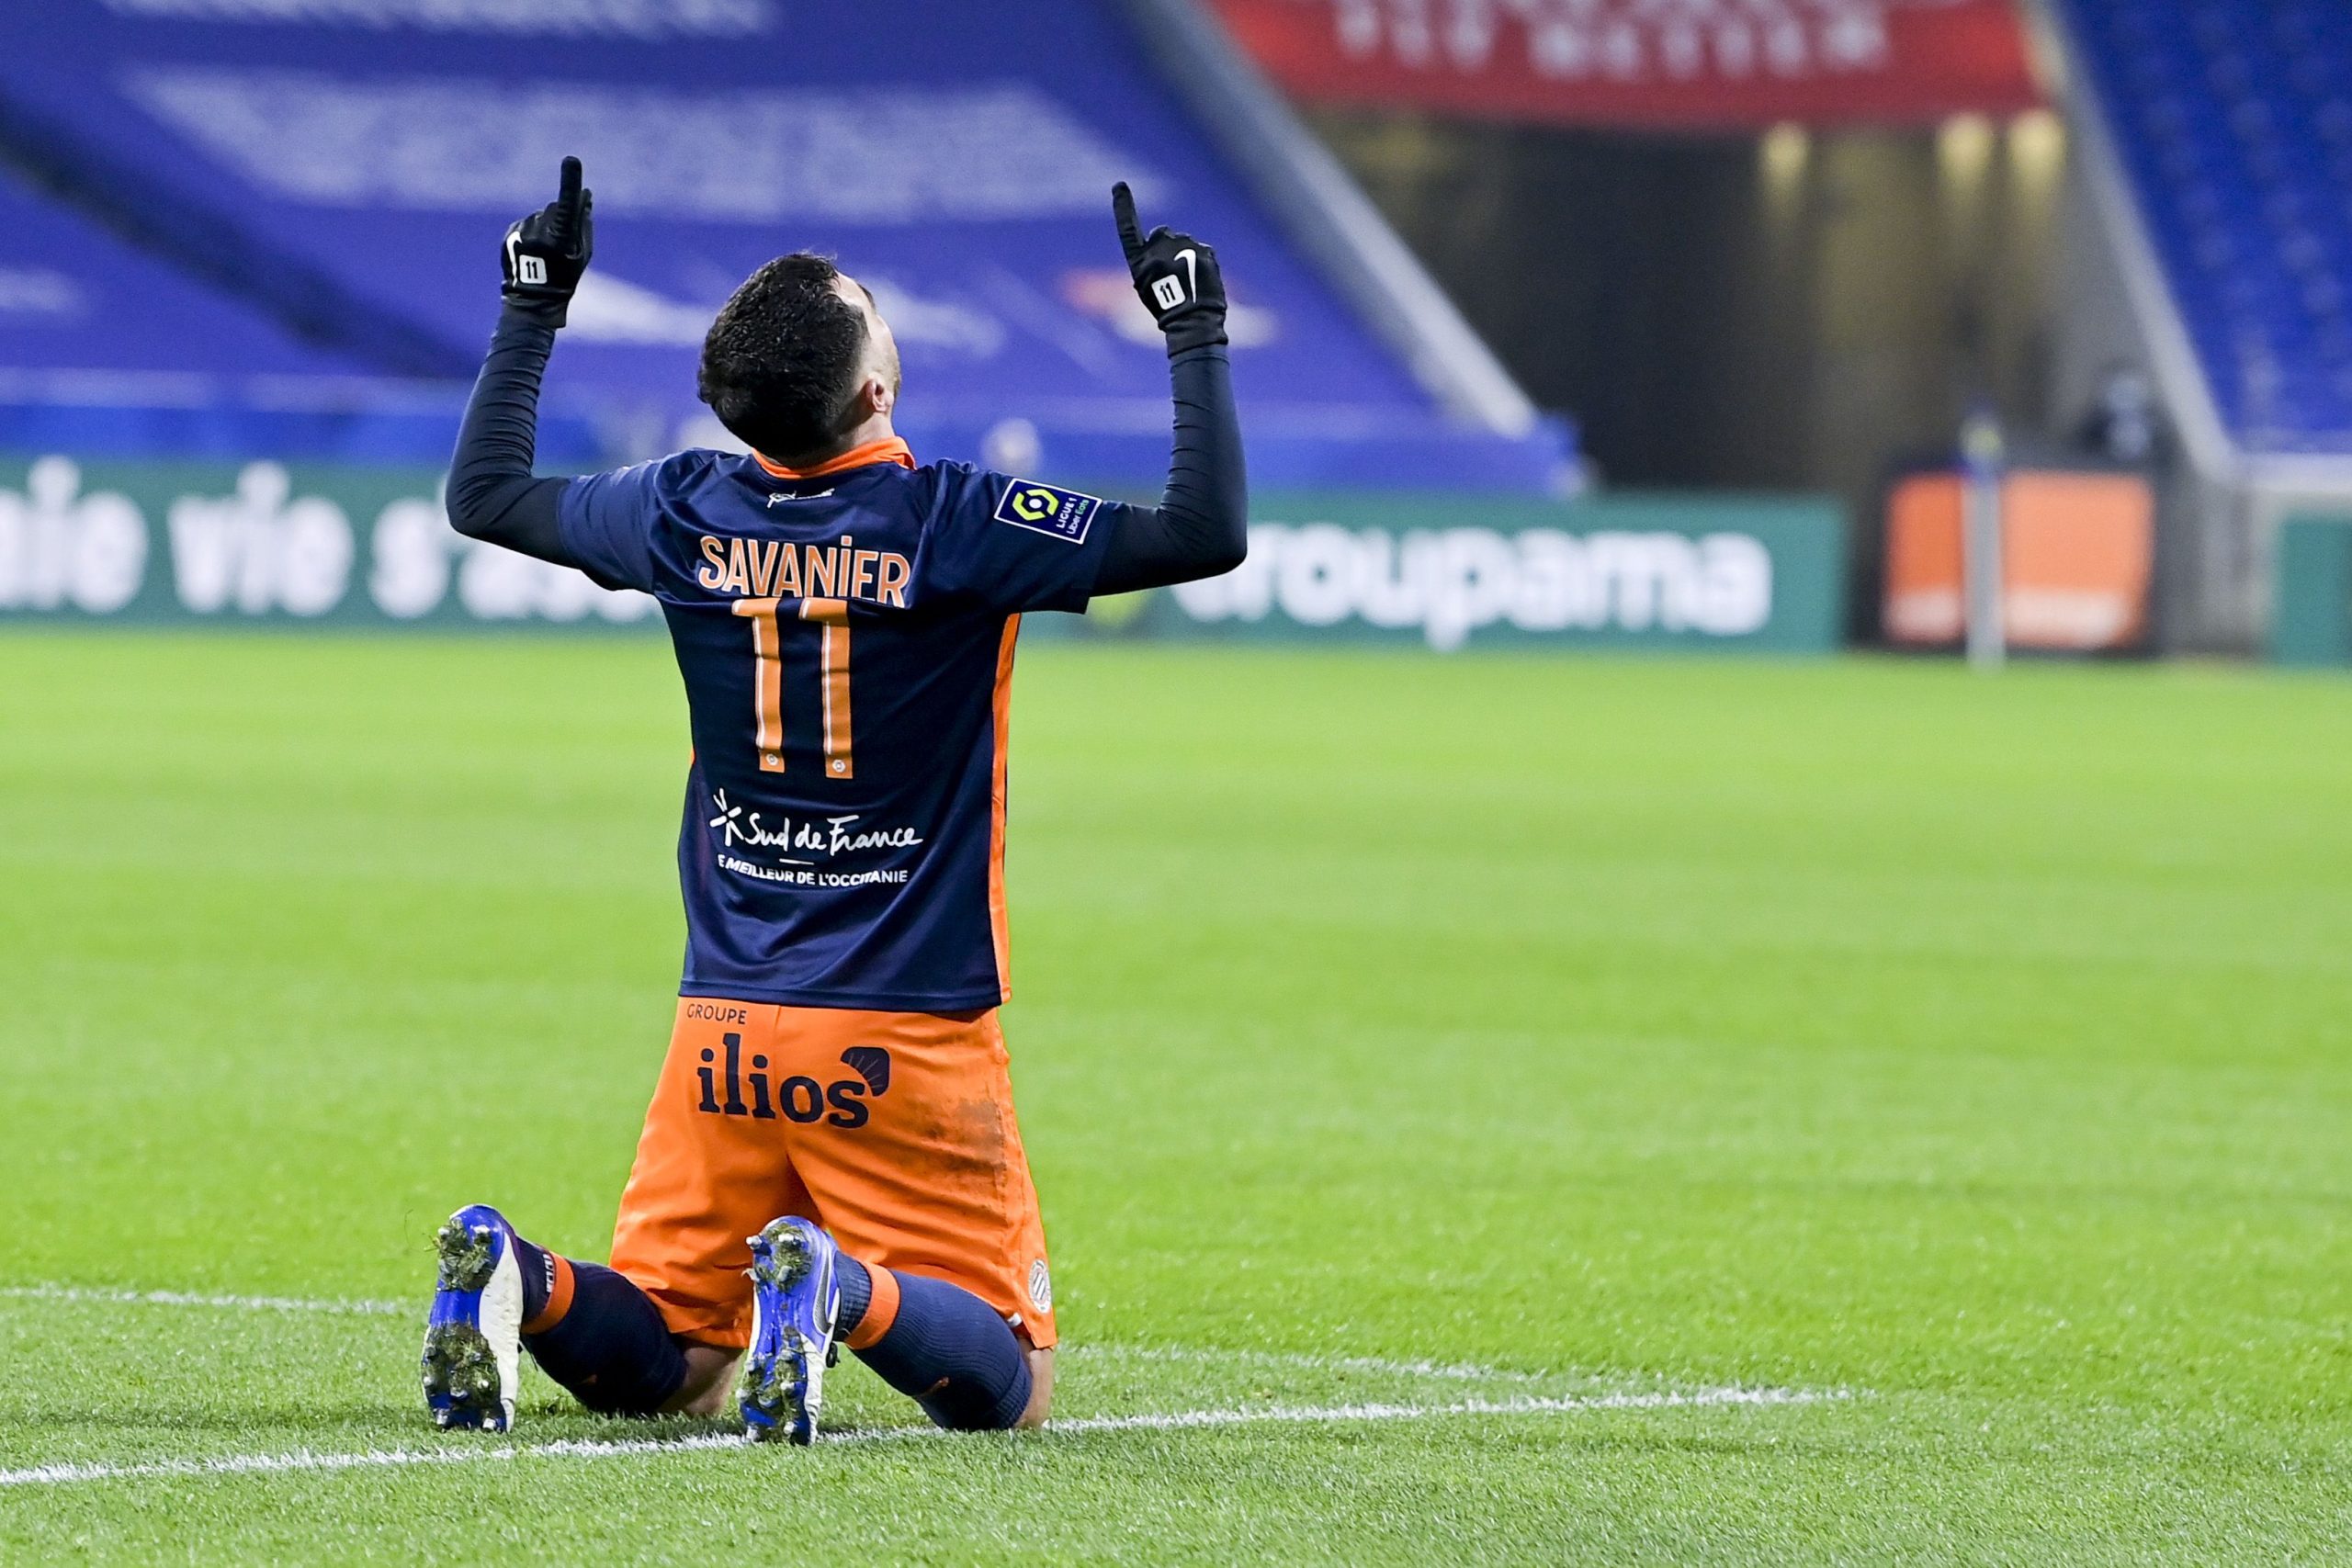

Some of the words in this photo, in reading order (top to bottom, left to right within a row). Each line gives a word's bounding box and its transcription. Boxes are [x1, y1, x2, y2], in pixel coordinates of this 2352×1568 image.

[525, 261, 538, 279] 11
[1159, 282, 1176, 303] 11
[167, 459, 355, 615] vie
[1171, 522, 1773, 652] roupama
[731, 596, 853, 779] 11
[744, 812, 790, 852] Sud
[794, 823, 828, 850] de
[827, 815, 923, 856] France
[725, 858, 795, 884] MEILLEUR
[797, 871, 816, 886] DE
[819, 870, 908, 886] L'OCCITANIE
[686, 1003, 747, 1025] GROUPE
[697, 1032, 869, 1129] ilios
